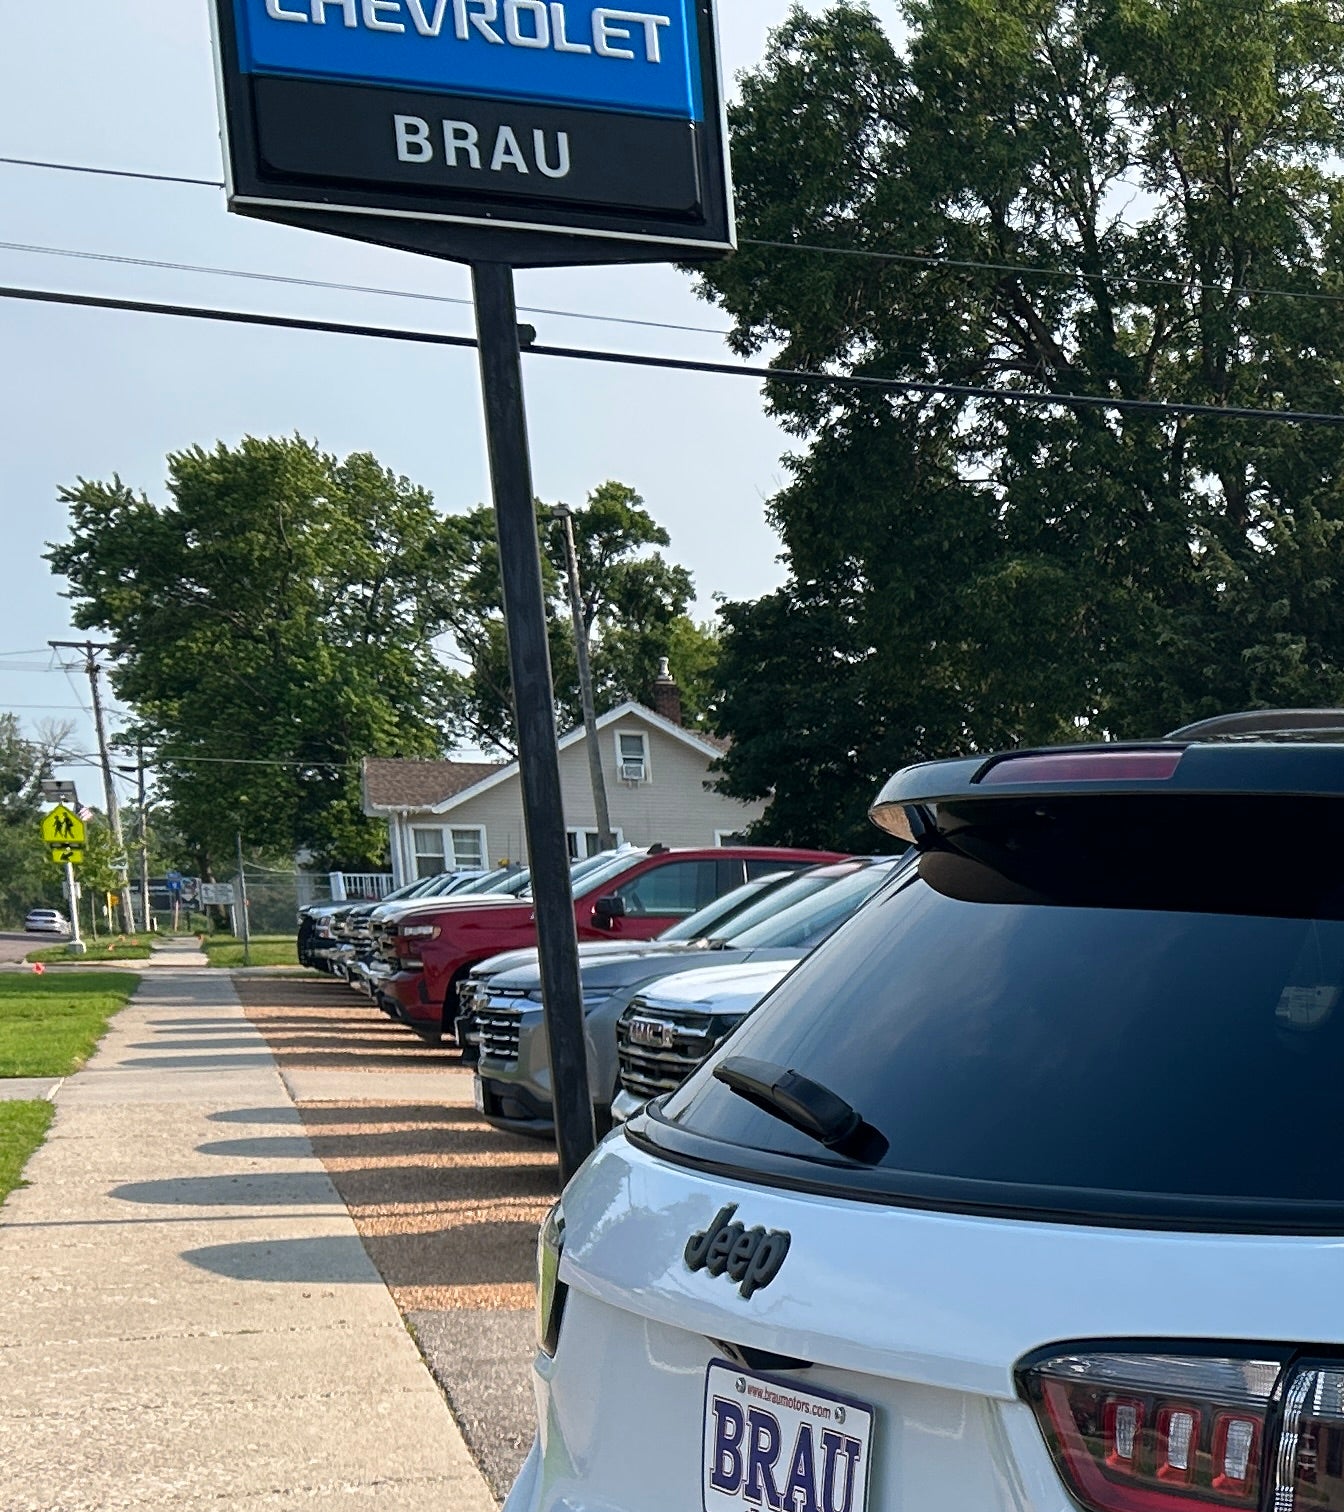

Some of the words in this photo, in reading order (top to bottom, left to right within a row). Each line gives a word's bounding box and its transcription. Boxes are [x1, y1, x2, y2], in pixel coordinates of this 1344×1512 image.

[393, 114, 572, 179] BRAU
[683, 1202, 792, 1301] Jeep
[747, 1385, 832, 1420] www.braumotors.com
